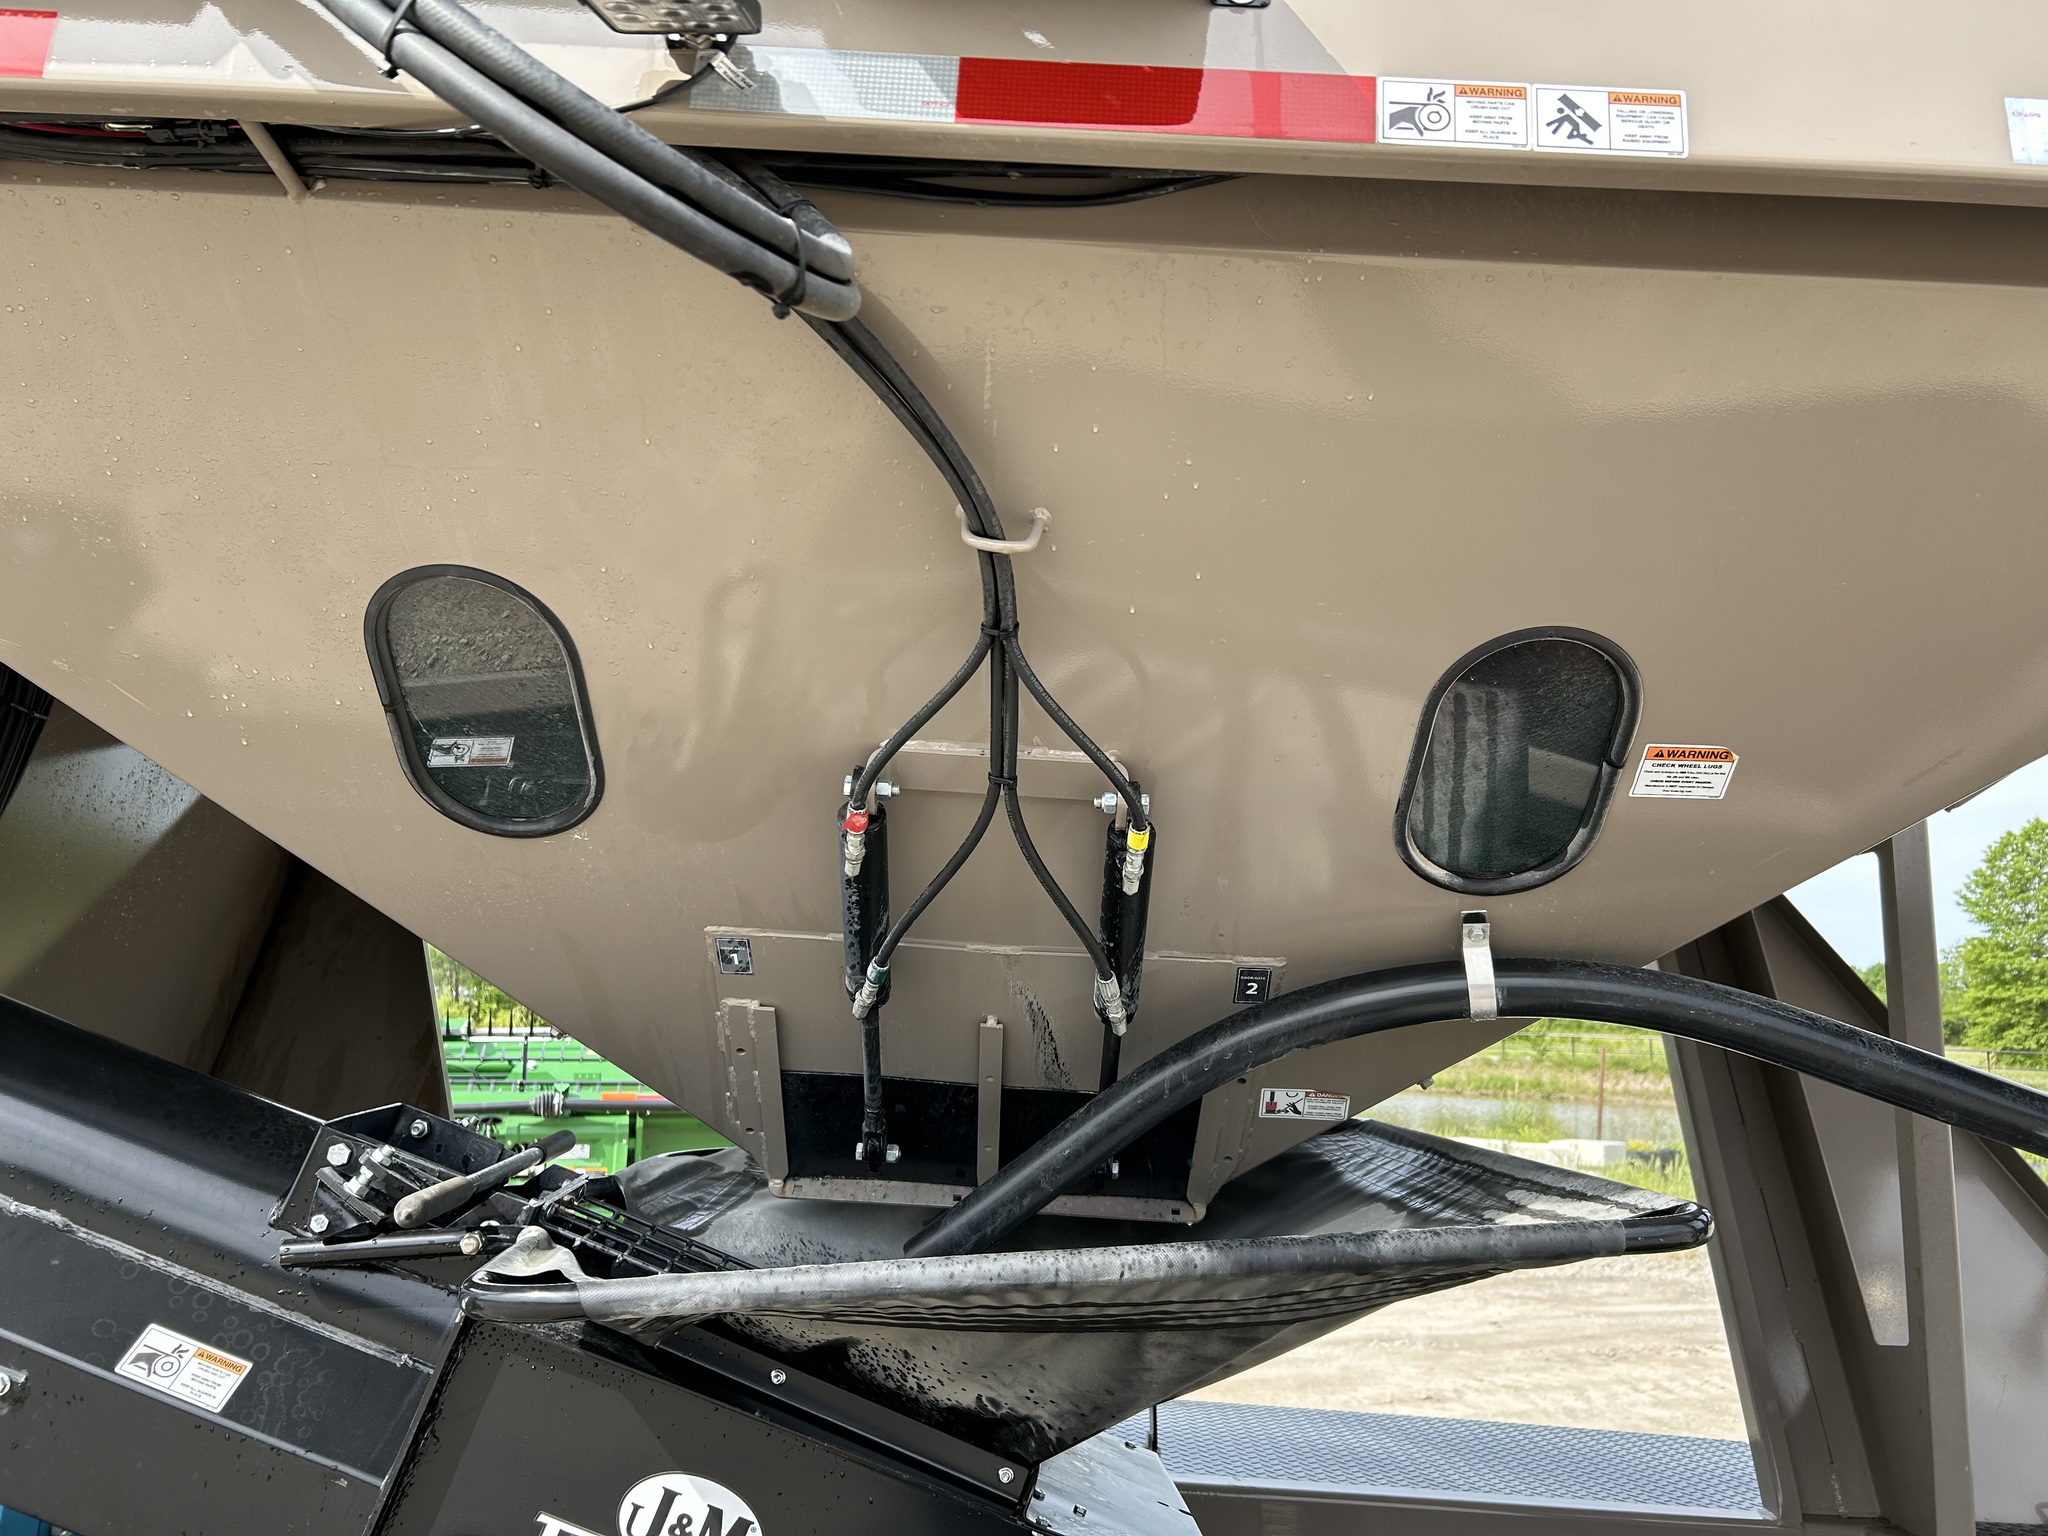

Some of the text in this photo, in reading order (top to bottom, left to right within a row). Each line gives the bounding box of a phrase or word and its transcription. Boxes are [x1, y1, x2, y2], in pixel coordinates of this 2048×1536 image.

[1468, 87, 1523, 97] WARNING
[1623, 94, 1677, 105] WARNING
[1667, 750, 1730, 760] WARNING
[730, 953, 739, 965] 1
[1245, 982, 1258, 995] 2
[205, 1353, 243, 1373] WARNING
